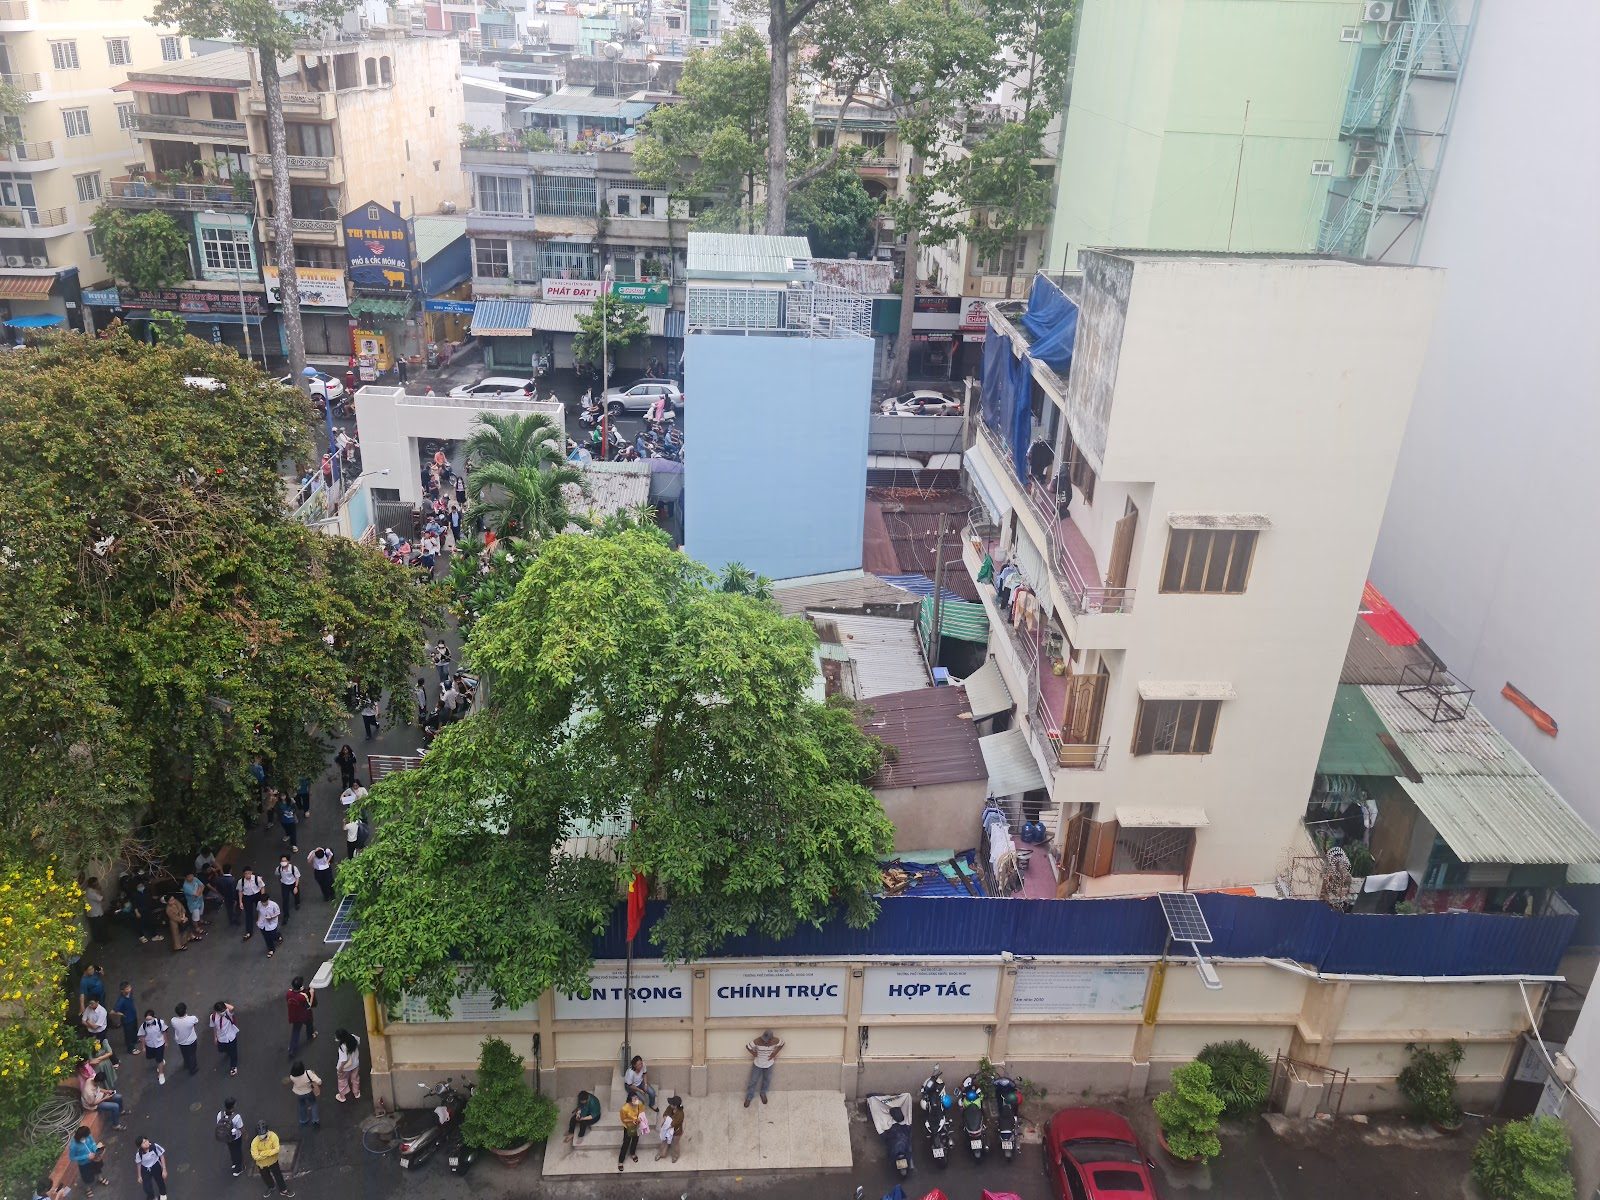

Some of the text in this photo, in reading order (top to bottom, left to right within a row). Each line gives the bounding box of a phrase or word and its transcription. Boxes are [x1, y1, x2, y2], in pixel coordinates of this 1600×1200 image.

[347, 226, 404, 240] THỊ TRẤN BÒ
[351, 255, 364, 266] PHỞ
[382, 256, 396, 265] MÓN
[397, 258, 406, 268] BÒ
[547, 286, 571, 295] PHÁT
[573, 289, 592, 298] ĐẠT
[610, 986, 683, 1003] TRỌNG
[717, 983, 838, 1001] CHÍNH TRỰC
[889, 982, 972, 1000] HỢP TÁC
